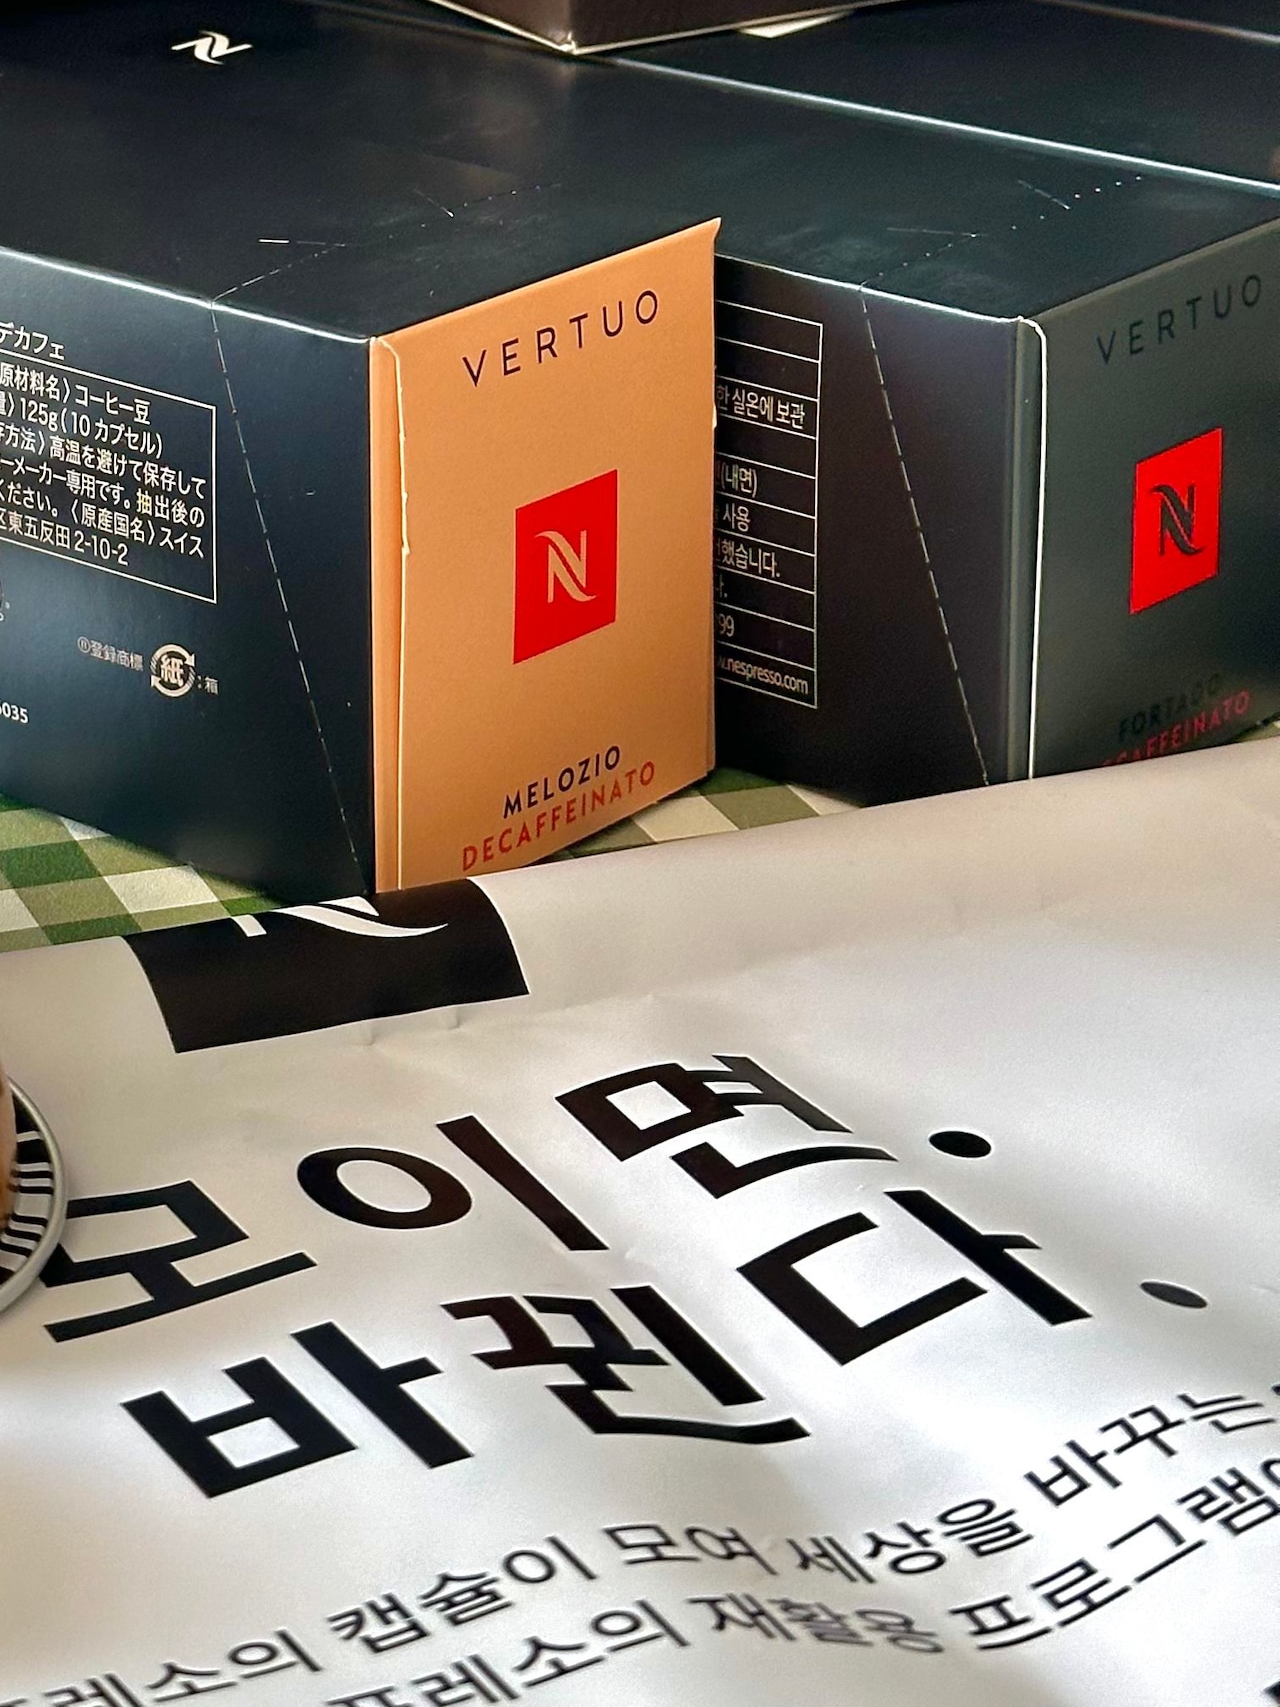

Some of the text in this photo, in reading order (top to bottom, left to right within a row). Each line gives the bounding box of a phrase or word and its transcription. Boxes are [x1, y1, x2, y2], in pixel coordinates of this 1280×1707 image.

[462, 288, 660, 388] VERTUO
[1096, 273, 1263, 366] VERTUO
[731, 390, 775, 424] 실온에
[776, 402, 806, 431] 보관
[717, 538, 782, 579] 했습니다.
[723, 502, 752, 532] 사용
[158, 655, 186, 688] 紙
[462, 759, 657, 873] DECAFFEINATO
[503, 744, 622, 819] MELOZIO
[327, 1390, 1278, 1655] 캡슐이 모여 세상을 바꾸는
[687, 1455, 1280, 1655] 재활용 프로그램
